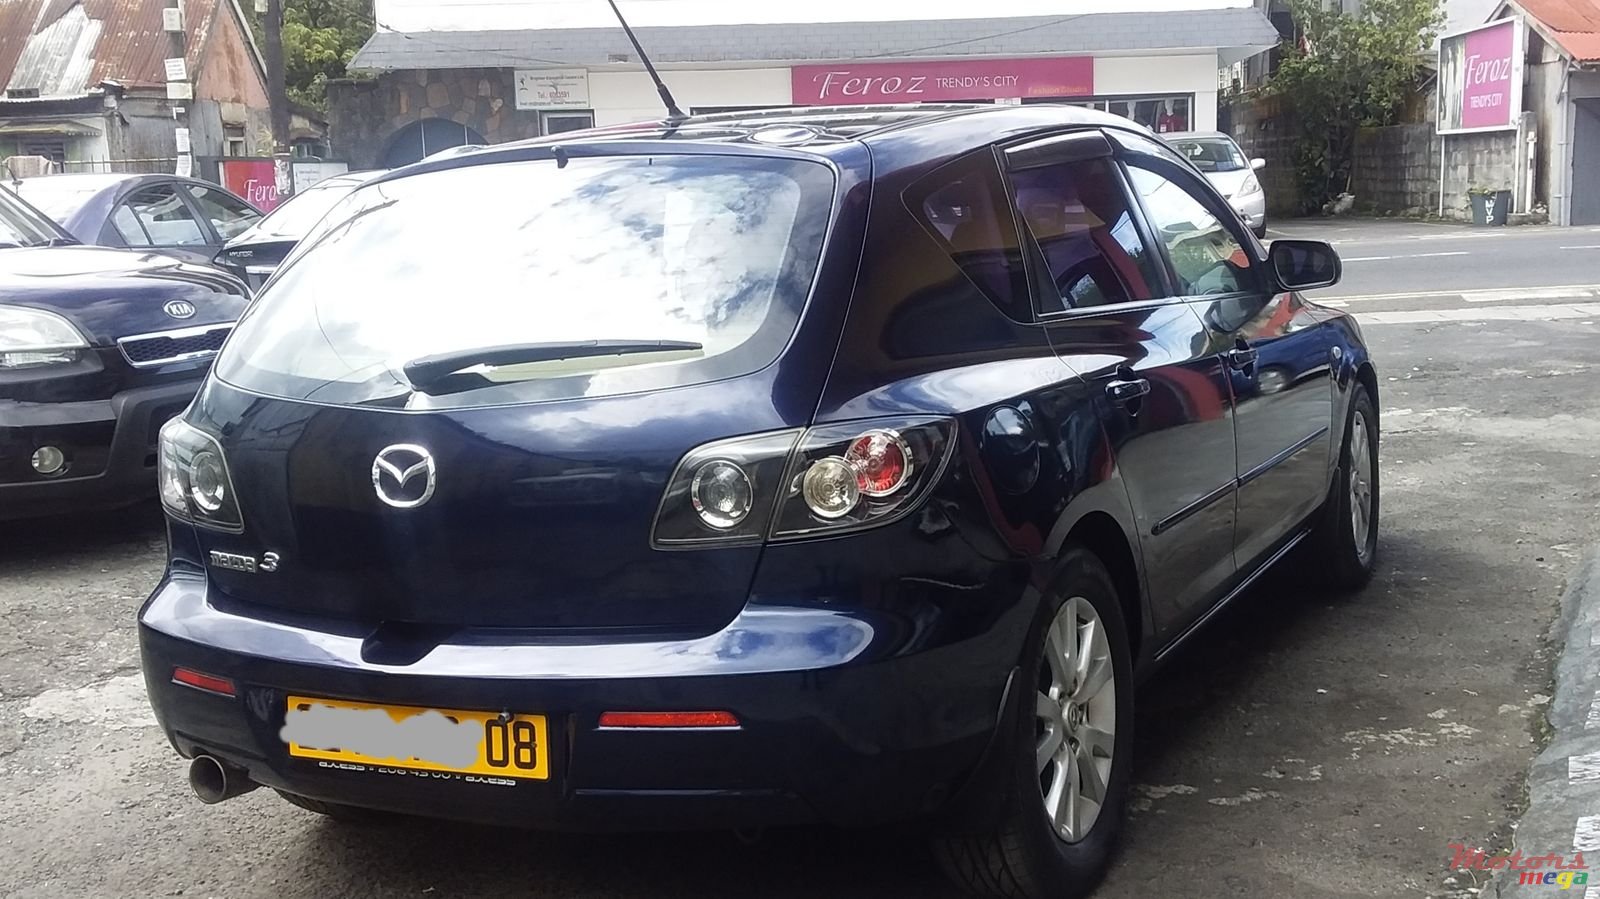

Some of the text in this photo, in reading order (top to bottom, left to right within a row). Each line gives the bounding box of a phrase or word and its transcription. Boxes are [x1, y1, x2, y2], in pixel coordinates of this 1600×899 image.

[1464, 54, 1511, 88] Feroz
[813, 71, 1019, 99] Feroz TRENDY'S CITY
[243, 179, 275, 202] Fero
[168, 302, 192, 315] KIA
[259, 551, 280, 572] 3
[485, 718, 537, 770] 08
